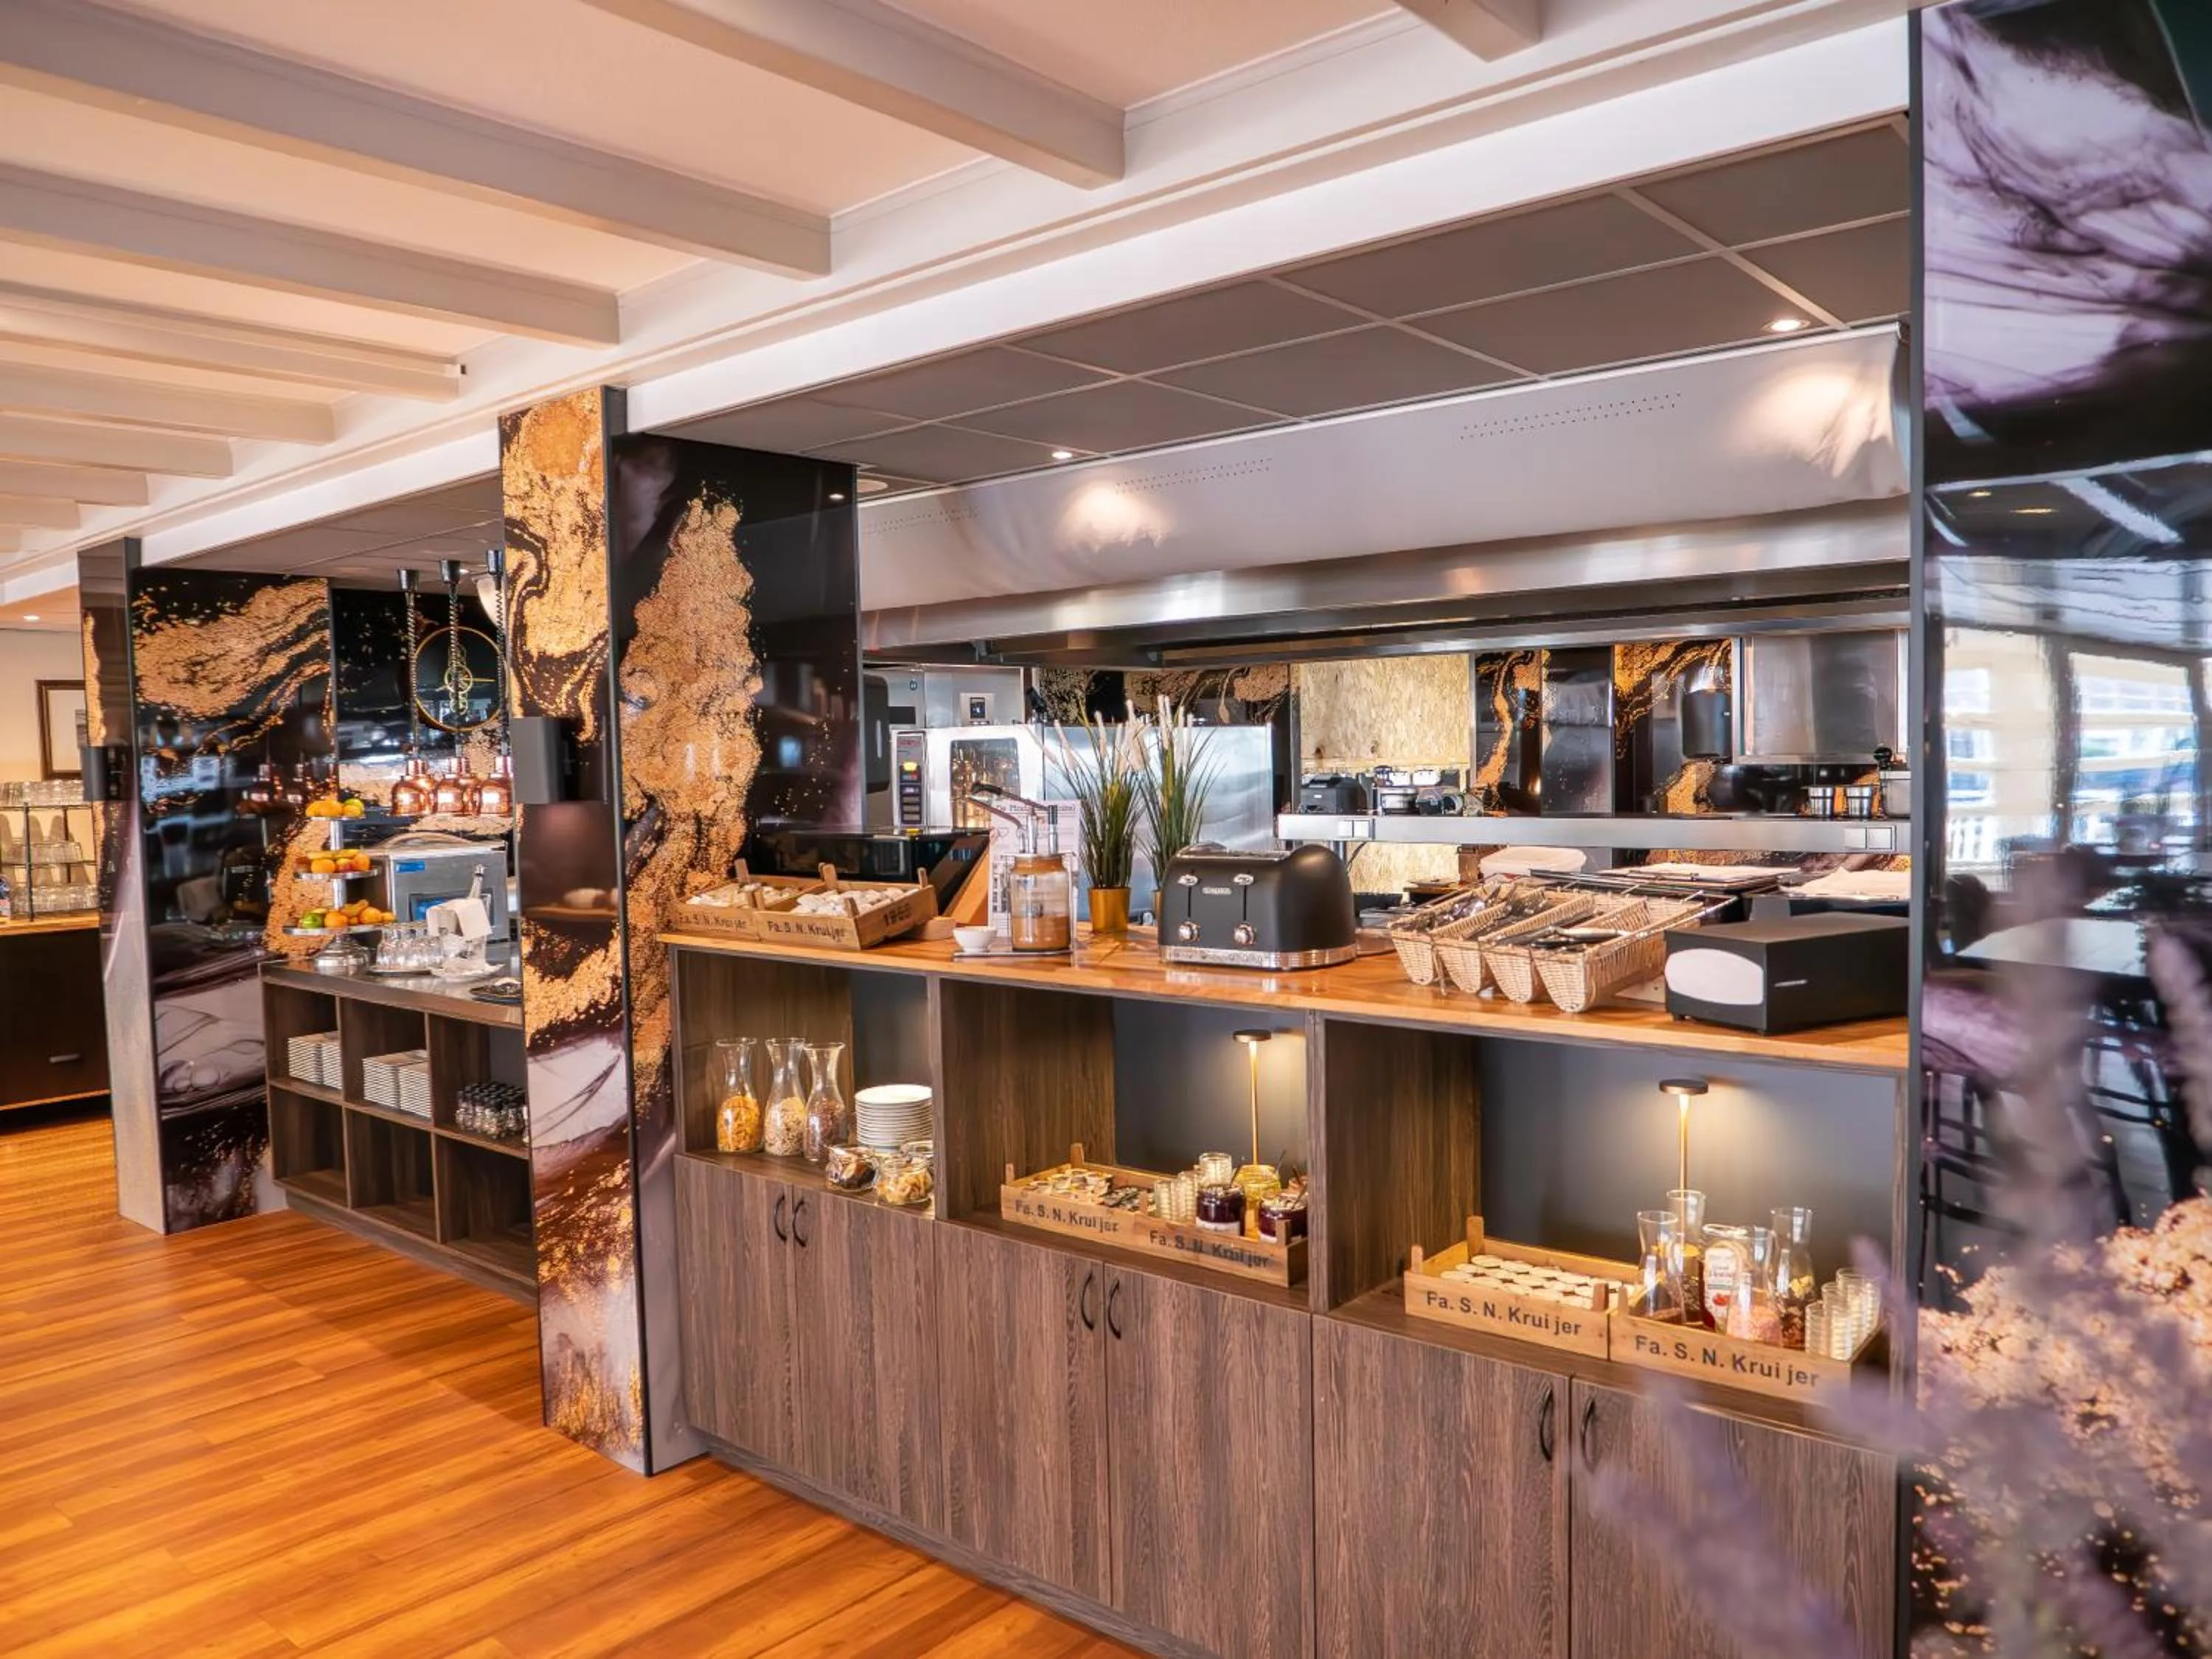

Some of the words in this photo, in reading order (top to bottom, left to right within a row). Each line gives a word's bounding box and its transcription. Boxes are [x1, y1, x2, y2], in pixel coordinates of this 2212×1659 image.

[1015, 1199, 1034, 1217] Fa.
[1052, 1206, 1067, 1222] N.
[1068, 1209, 1119, 1234] Kruijer
[1149, 1229, 1171, 1247] Fa.
[1426, 1290, 1454, 1310] Fa.
[1459, 1296, 1478, 1315] S.
[1483, 1301, 1503, 1321] N.
[1508, 1305, 1582, 1335] Kruijer
[1634, 1334, 1668, 1357] Fa.
[1674, 1342, 1696, 1363] S.
[1702, 1347, 1725, 1368] N.
[1731, 1352, 1820, 1387] Kruijer
